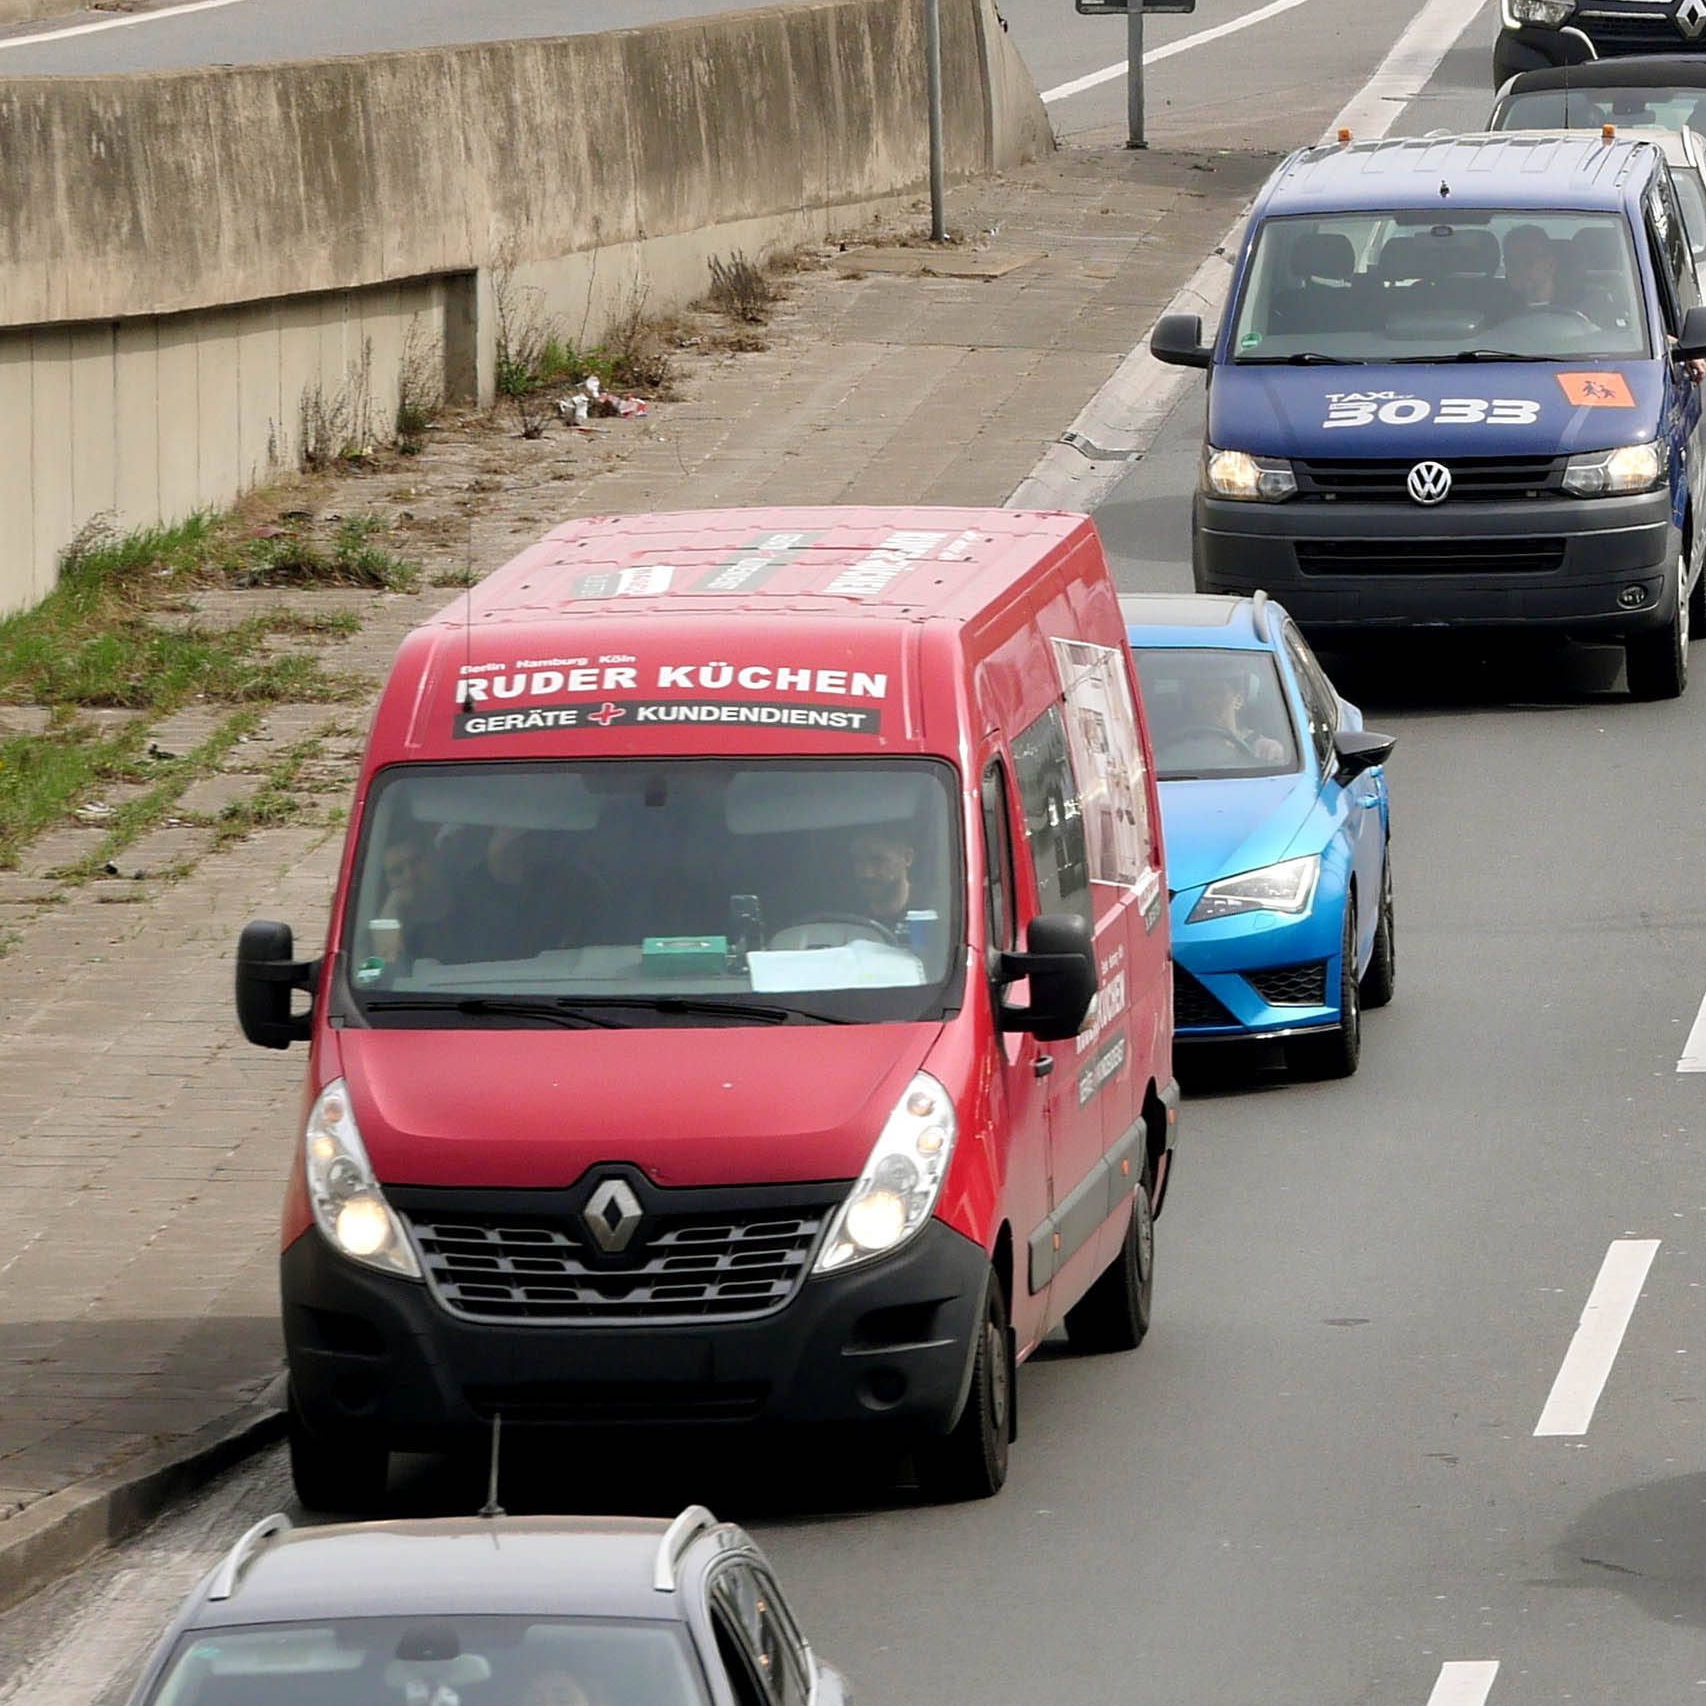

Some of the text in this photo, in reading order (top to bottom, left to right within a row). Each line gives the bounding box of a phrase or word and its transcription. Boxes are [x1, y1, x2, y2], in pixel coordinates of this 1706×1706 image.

[1325, 390, 1395, 403] TAXI
[1322, 398, 1541, 429] 3033
[460, 653, 637, 674] Berlin Hamburg Köln
[455, 660, 888, 704] RUDER KÜCHEN
[464, 708, 578, 735] GERÄTE
[636, 704, 867, 729] KUNDENDIENST
